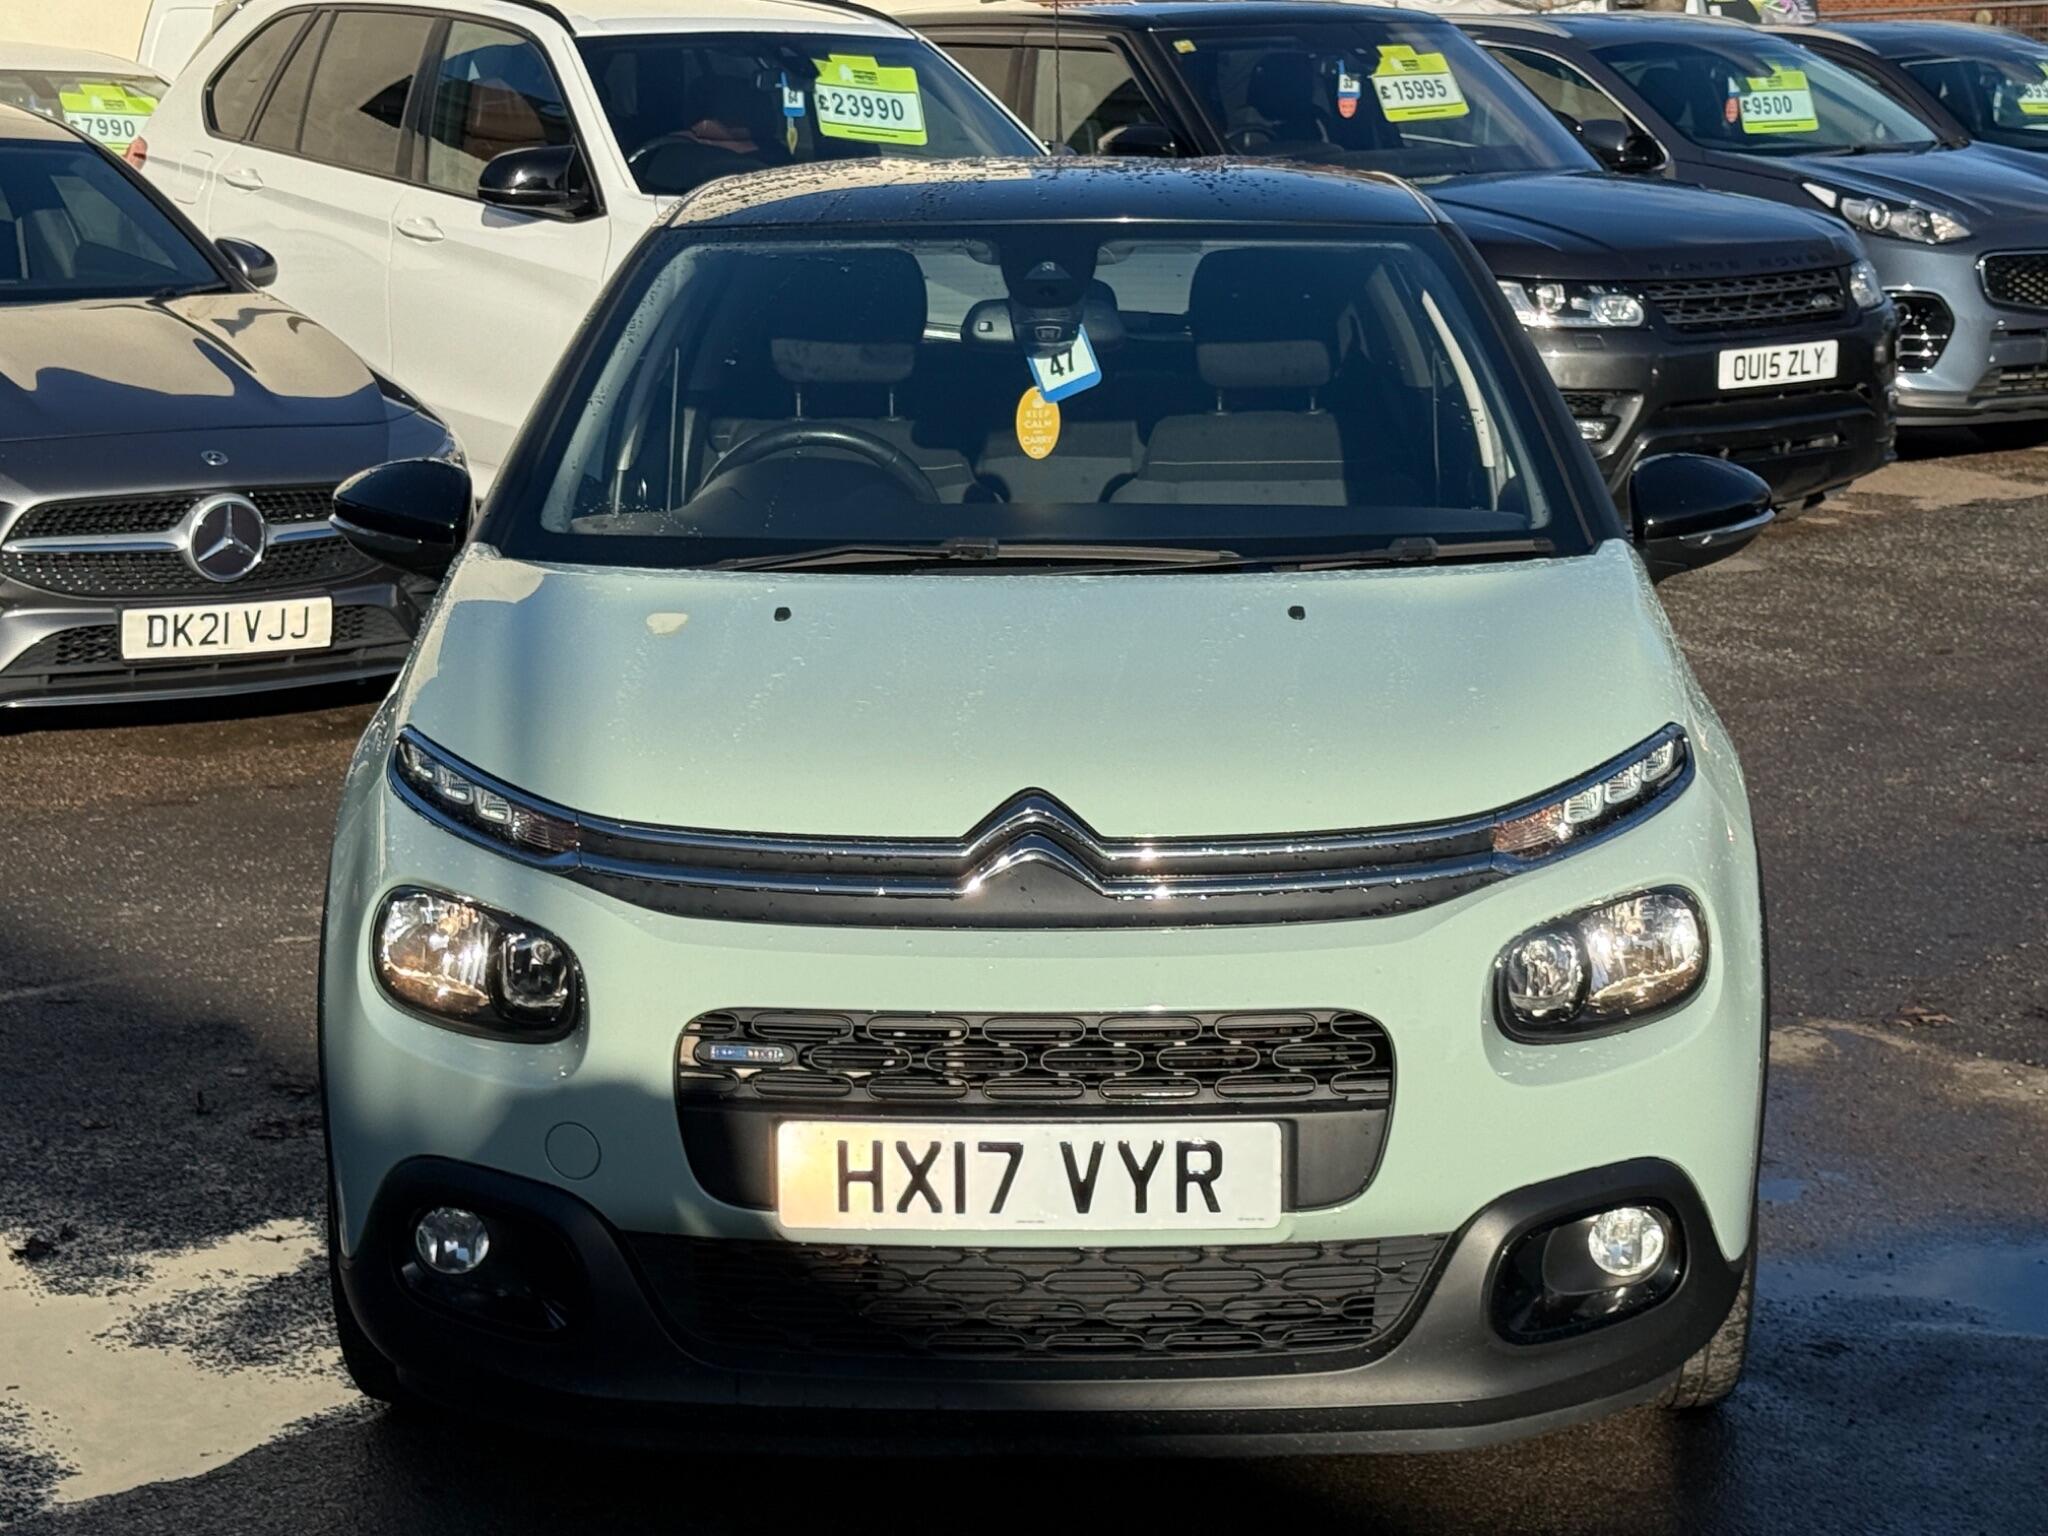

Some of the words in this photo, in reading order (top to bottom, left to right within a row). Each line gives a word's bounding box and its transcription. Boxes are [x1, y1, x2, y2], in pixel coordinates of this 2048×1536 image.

[1380, 79, 1448, 101] £15995
[1743, 95, 1792, 115] £9500
[818, 92, 904, 121] £23990
[1733, 352, 1781, 382] OU15
[1787, 347, 1826, 377] ZLY
[146, 611, 230, 649] DK21
[244, 606, 310, 643] VJJ
[837, 1139, 1025, 1214] HX17
[1060, 1138, 1224, 1214] VYR
